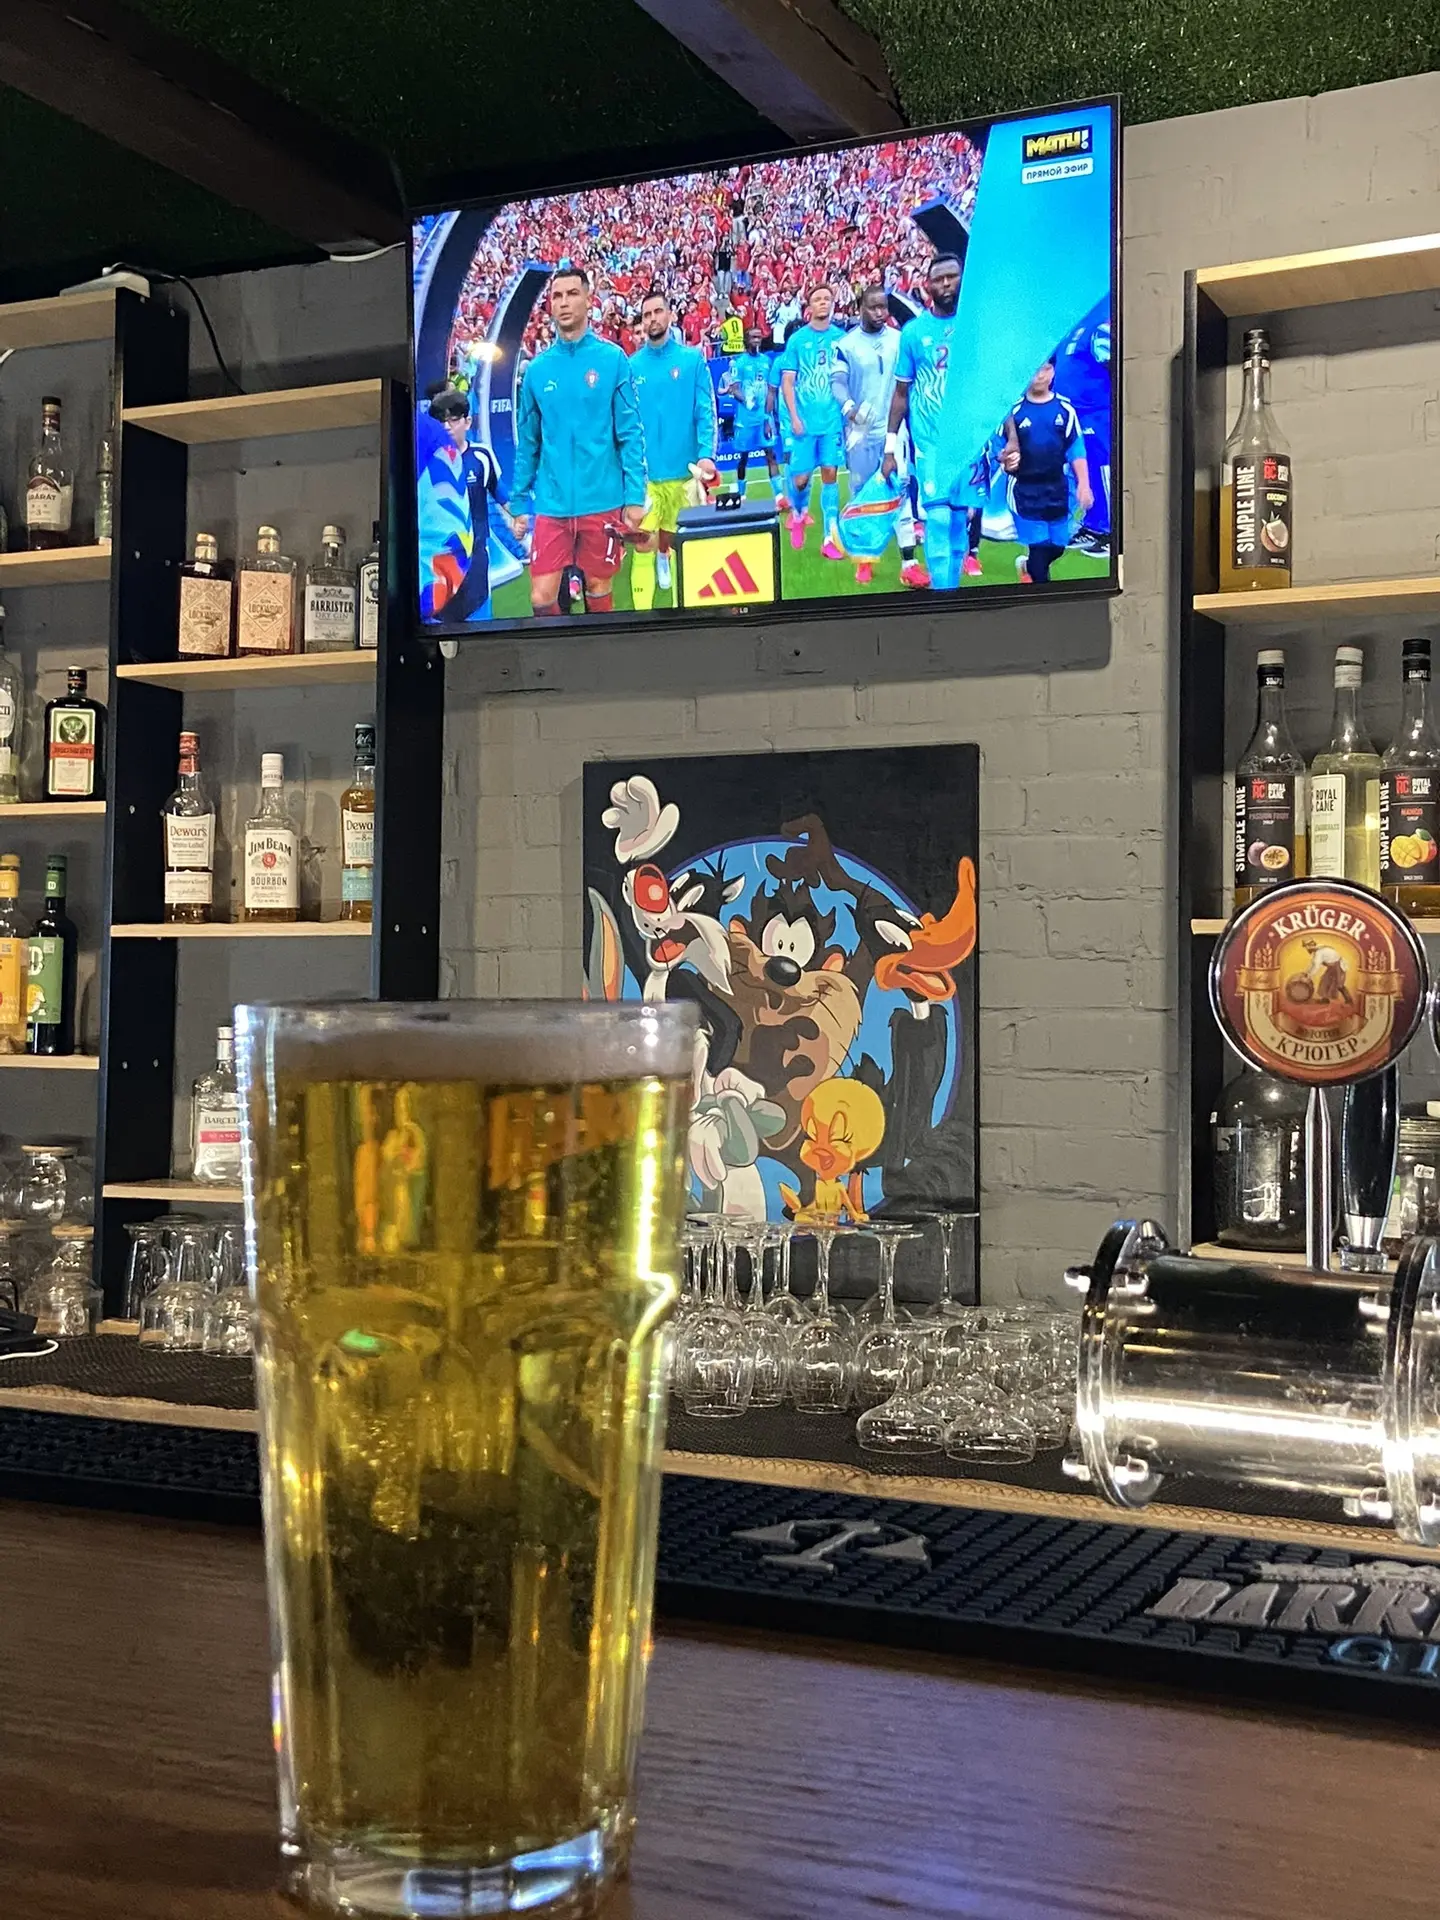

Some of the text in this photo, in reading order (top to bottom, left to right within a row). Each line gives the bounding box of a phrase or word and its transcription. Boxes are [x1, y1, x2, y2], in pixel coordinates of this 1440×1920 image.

[1027, 129, 1089, 157] МАТЧ!
[1026, 163, 1089, 180] ПРЯМОЙ ЭФИР
[492, 398, 512, 413] FIFA
[1236, 465, 1255, 553] SIMPLE LINE
[310, 599, 354, 613] BARRISTER
[1315, 788, 1338, 800] ROYAL
[1315, 800, 1334, 812] CANE
[1235, 786, 1246, 872] SIMPLE LINE
[1380, 781, 1390, 870] SIMPLE LINE
[248, 837, 292, 857] JIM BEAM
[250, 876, 288, 886] BOURBON
[1272, 904, 1367, 941] KRÜGER
[1276, 1036, 1359, 1062] КРЮГЕР
